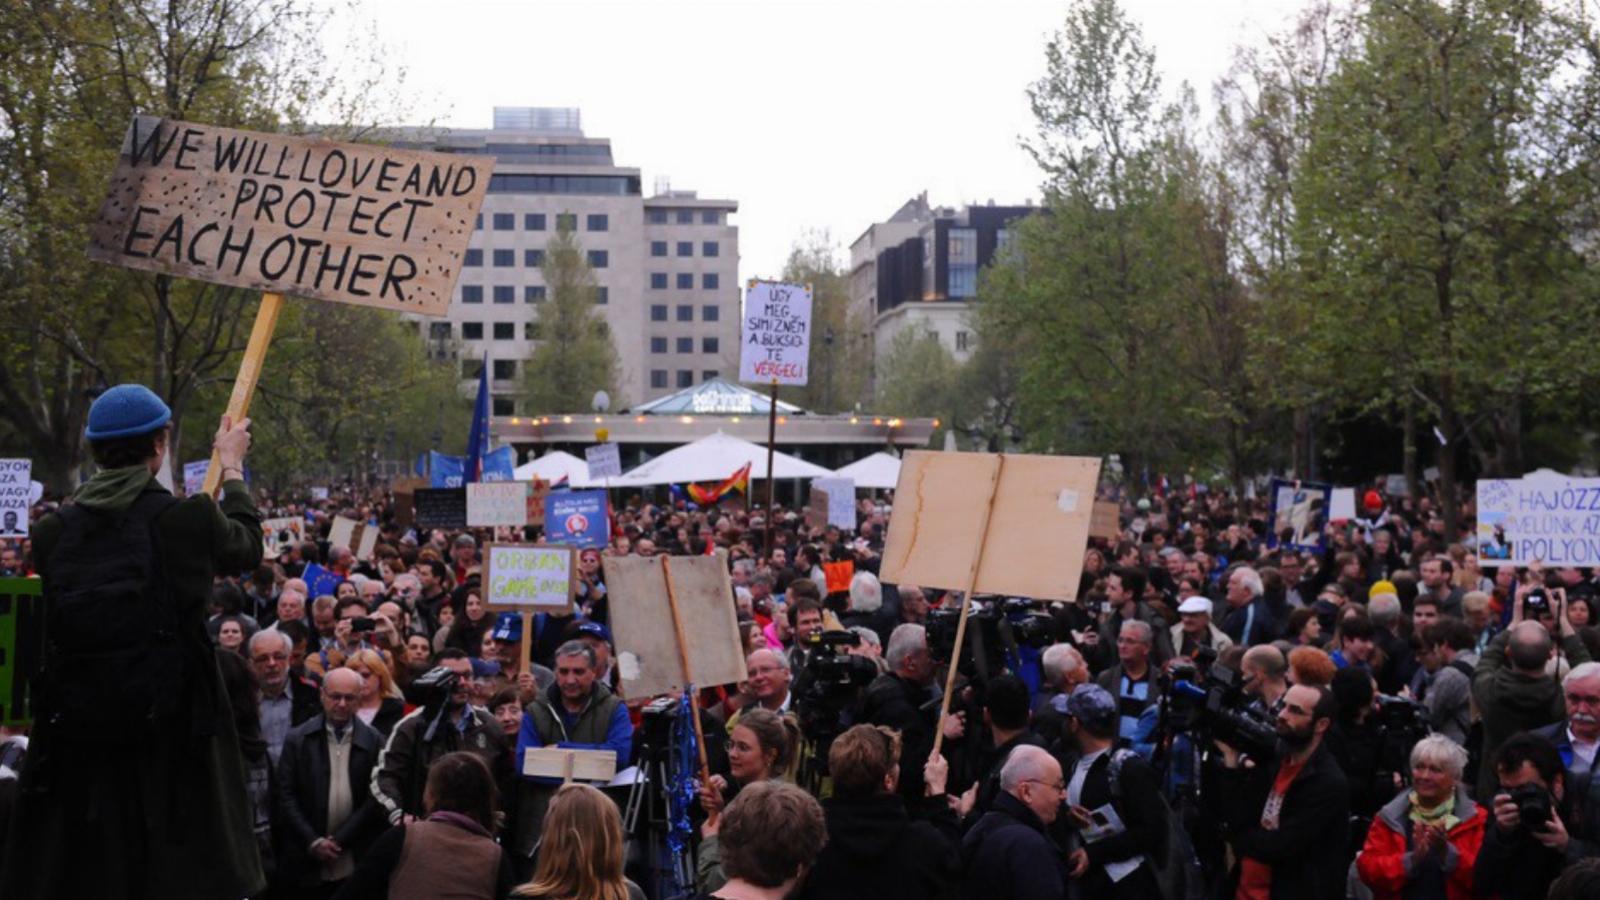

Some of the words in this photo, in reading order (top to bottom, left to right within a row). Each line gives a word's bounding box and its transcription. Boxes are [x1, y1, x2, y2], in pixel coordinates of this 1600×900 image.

[130, 117, 205, 170] WE
[213, 136, 290, 181] WILL
[298, 149, 402, 192] LOVE
[402, 163, 477, 197] AND
[124, 206, 254, 275] EACH
[231, 178, 433, 242] PROTECT
[766, 348, 783, 361] TE
